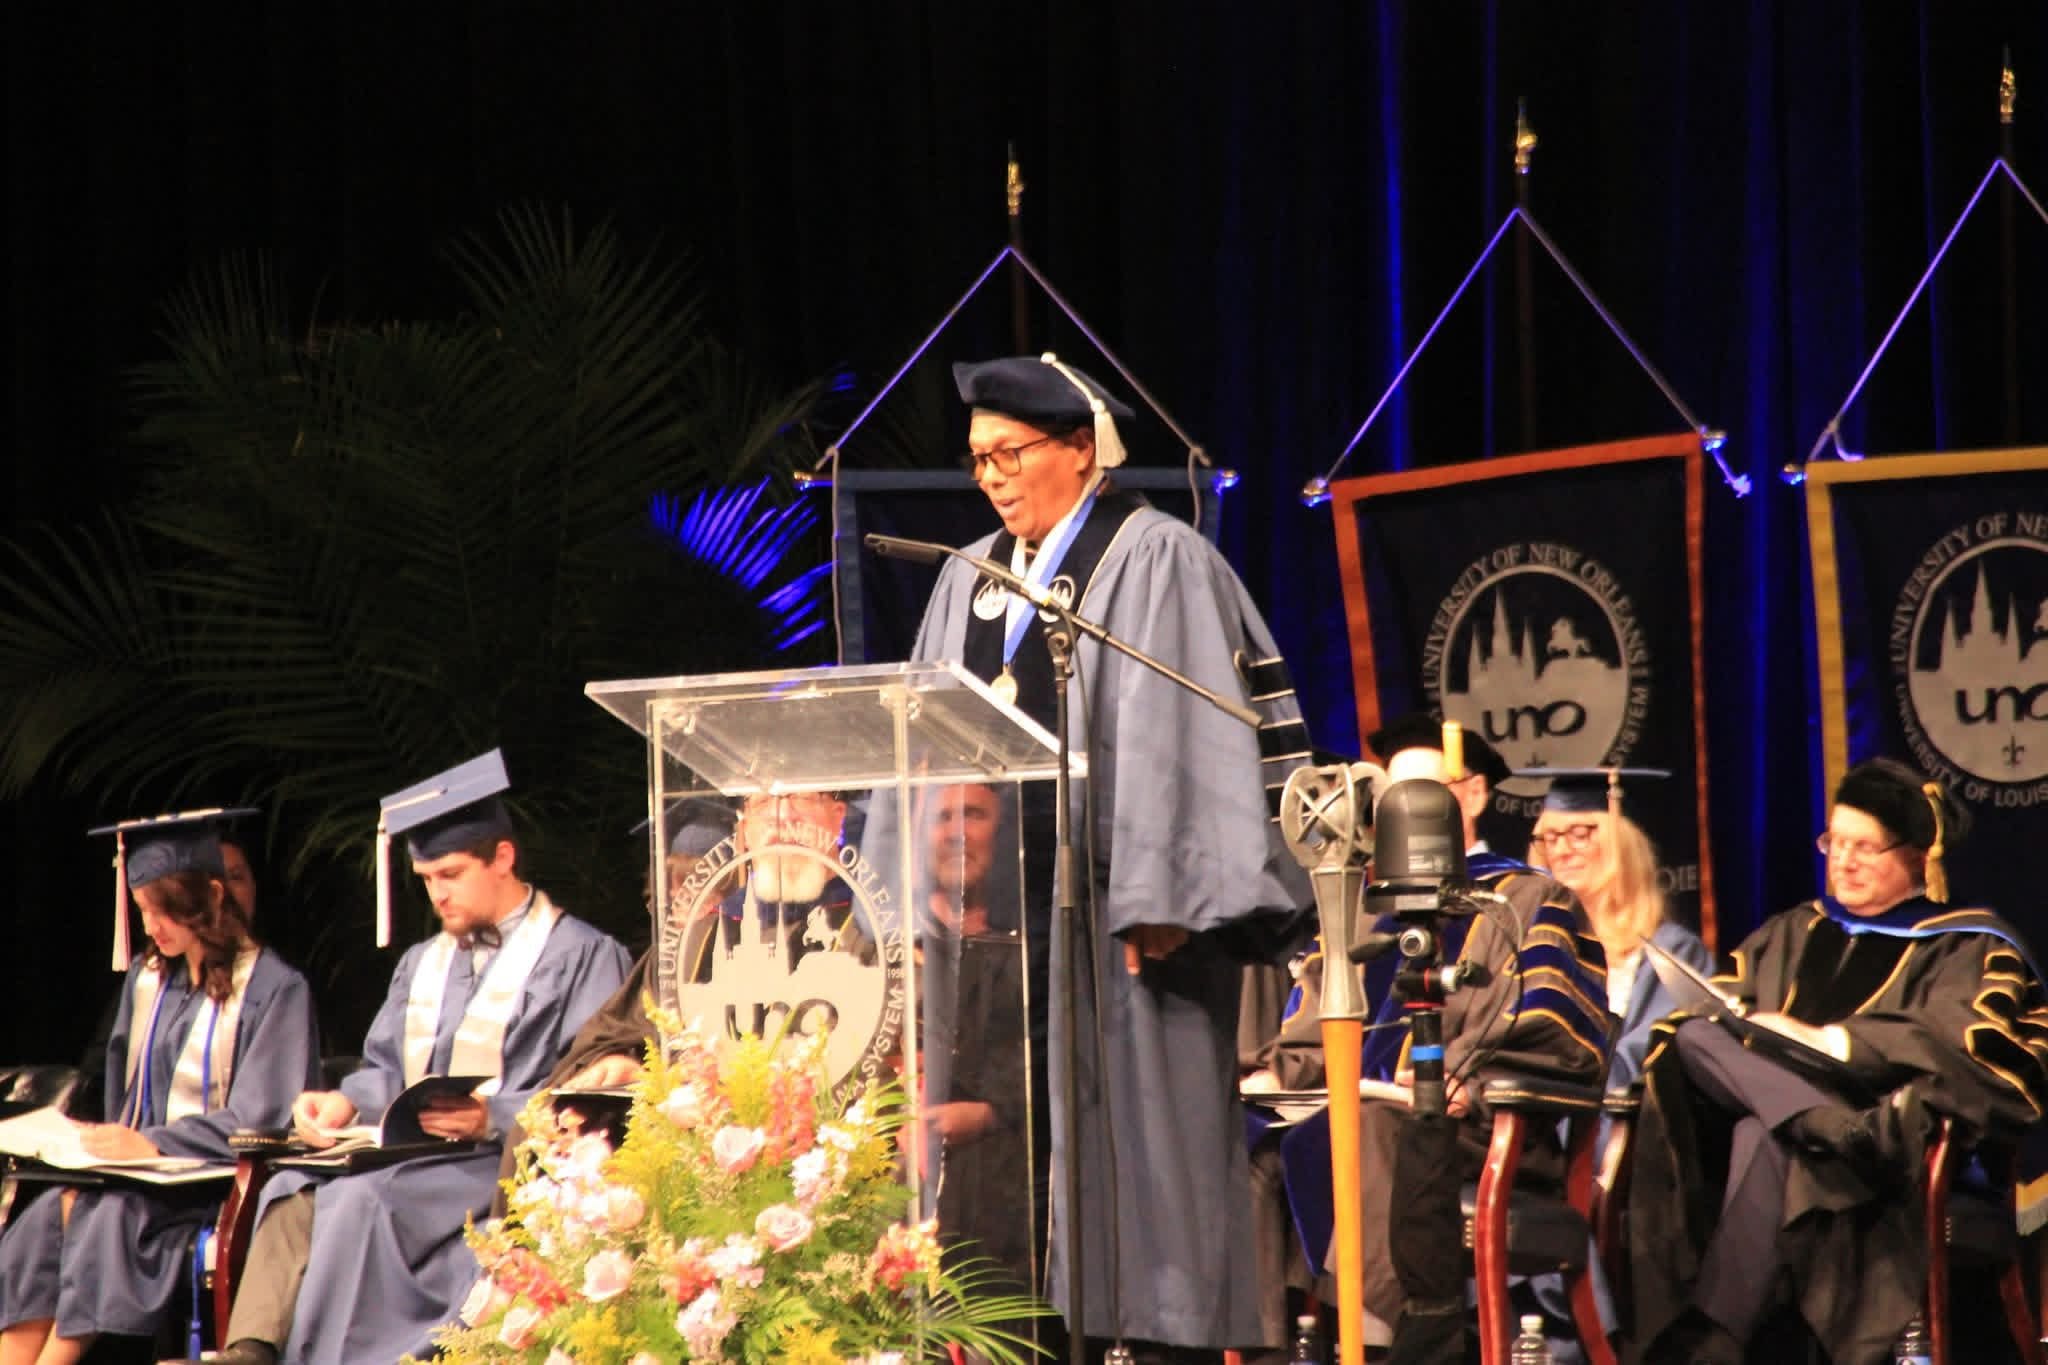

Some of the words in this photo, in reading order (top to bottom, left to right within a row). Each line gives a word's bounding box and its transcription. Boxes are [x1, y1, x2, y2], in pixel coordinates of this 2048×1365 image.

[1422, 556, 1491, 686] UNIVERSITY
[1493, 544, 1521, 568] OF
[1527, 543, 1582, 568] NEW
[1580, 560, 1648, 664] ORLEANS
[1890, 525, 1969, 662] UNIVERSITY
[1976, 513, 2008, 539] OF
[2016, 512, 2048, 537] NE
[1482, 700, 1586, 742] uno
[1964, 784, 1988, 802] OF
[1994, 786, 2048, 808] LOUIS
[840, 845, 905, 964] ORLEANS
[861, 986, 904, 1077] SYSTEM
